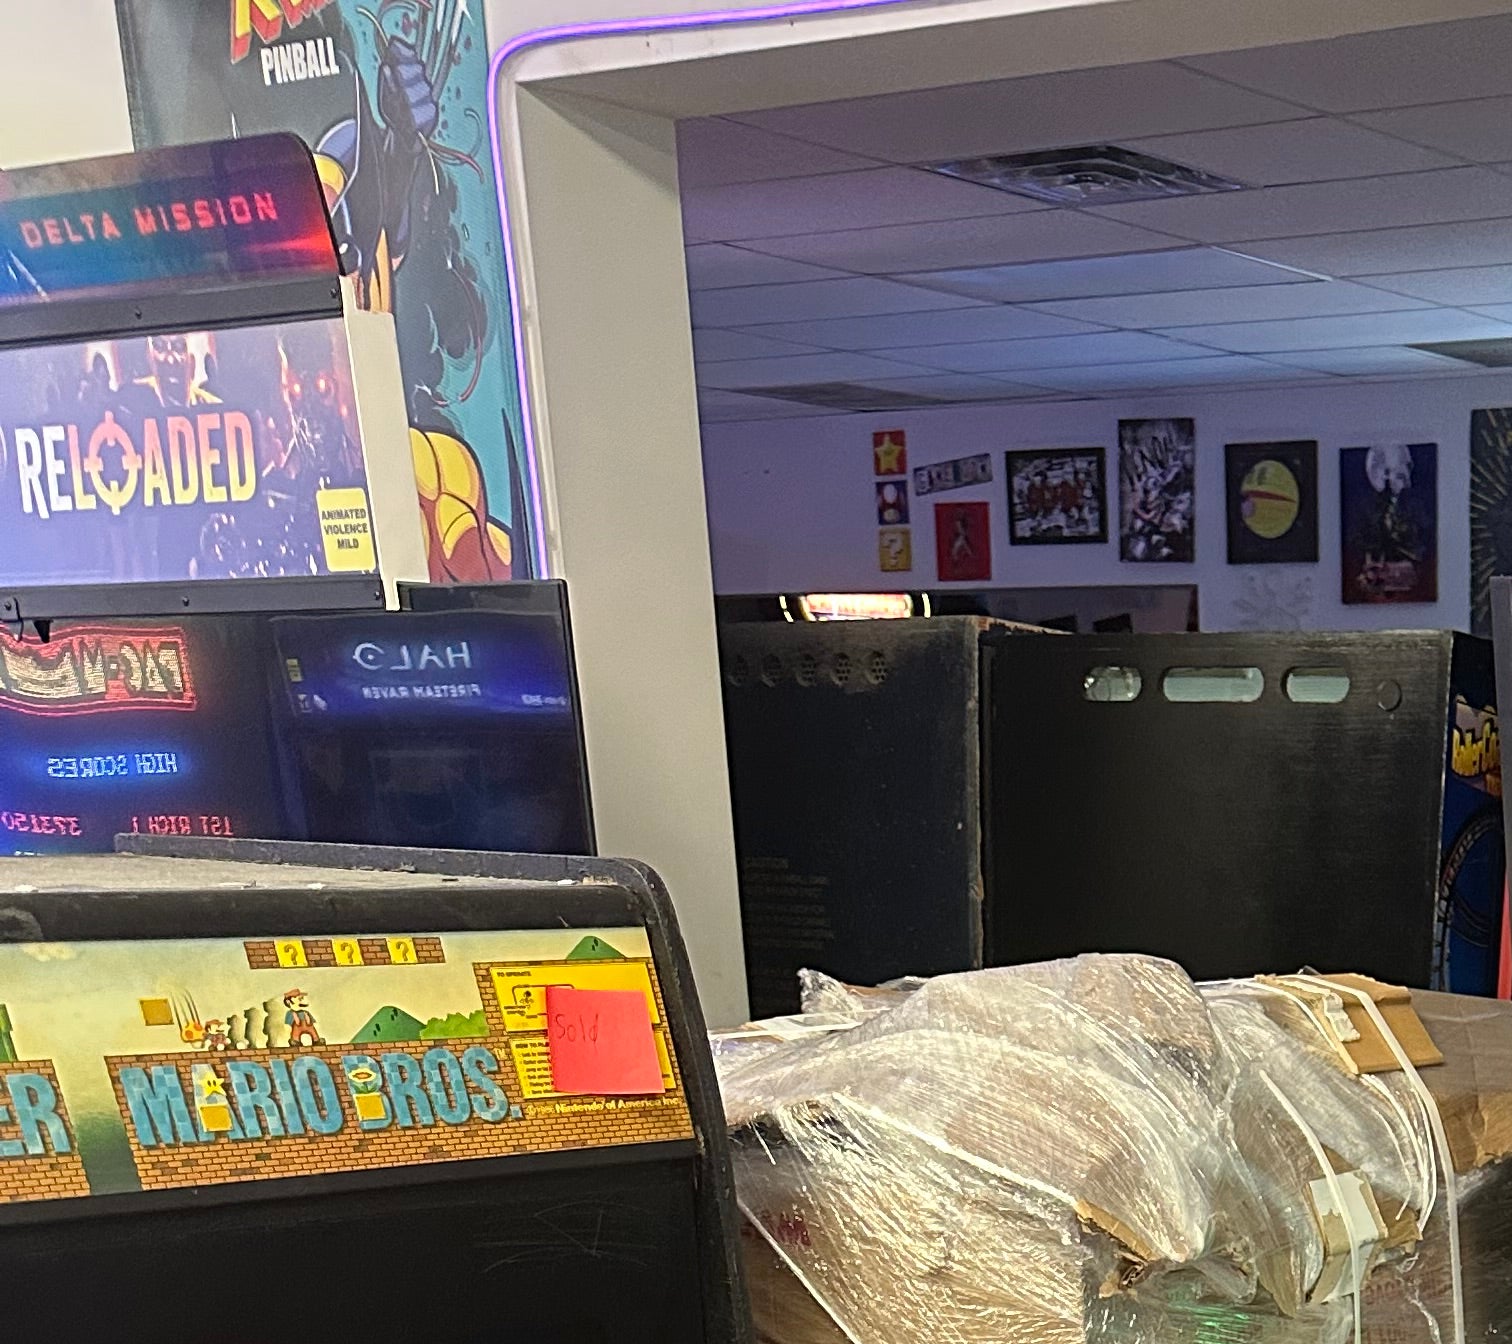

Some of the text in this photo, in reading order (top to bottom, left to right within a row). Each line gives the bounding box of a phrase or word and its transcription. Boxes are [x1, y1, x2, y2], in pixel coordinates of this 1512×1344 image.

[261, 37, 340, 86] PINBALL
[18, 192, 279, 249] DELTA MISSION
[15, 410, 258, 519] RELOADED
[321, 508, 367, 521] ANIMATED
[323, 523, 368, 536] VIOLENCE
[337, 537, 360, 550] MILD
[555, 1013, 599, 1046] Sold
[118, 1054, 347, 1150] MARIO
[350, 1046, 524, 1131] BROS.
